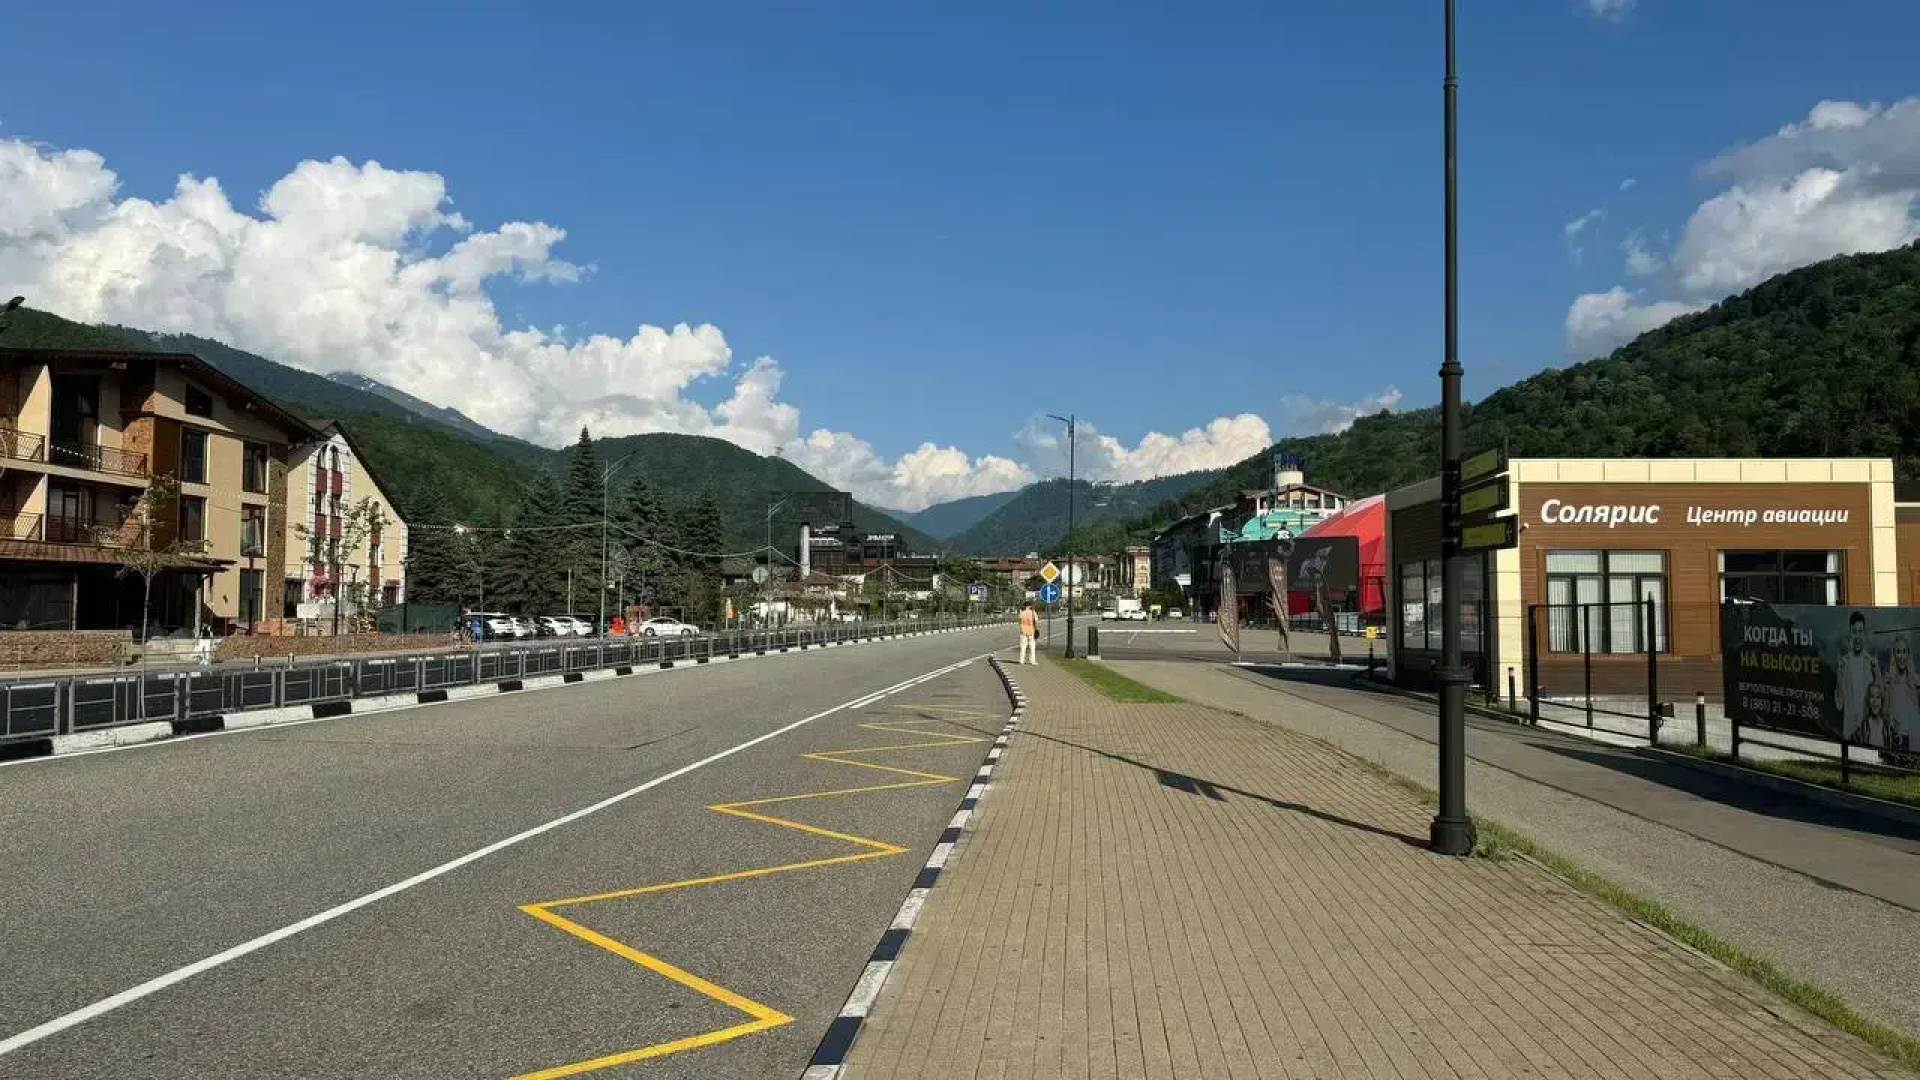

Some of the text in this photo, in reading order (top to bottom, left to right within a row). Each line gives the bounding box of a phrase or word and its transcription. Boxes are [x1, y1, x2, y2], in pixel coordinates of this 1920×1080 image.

[1541, 499, 1660, 528] Солярис
[1686, 506, 1849, 526] Центр авиации
[1743, 625, 1813, 647] КОГДА ТЫ
[1740, 651, 1820, 674] НА ВЫСОТЕ
